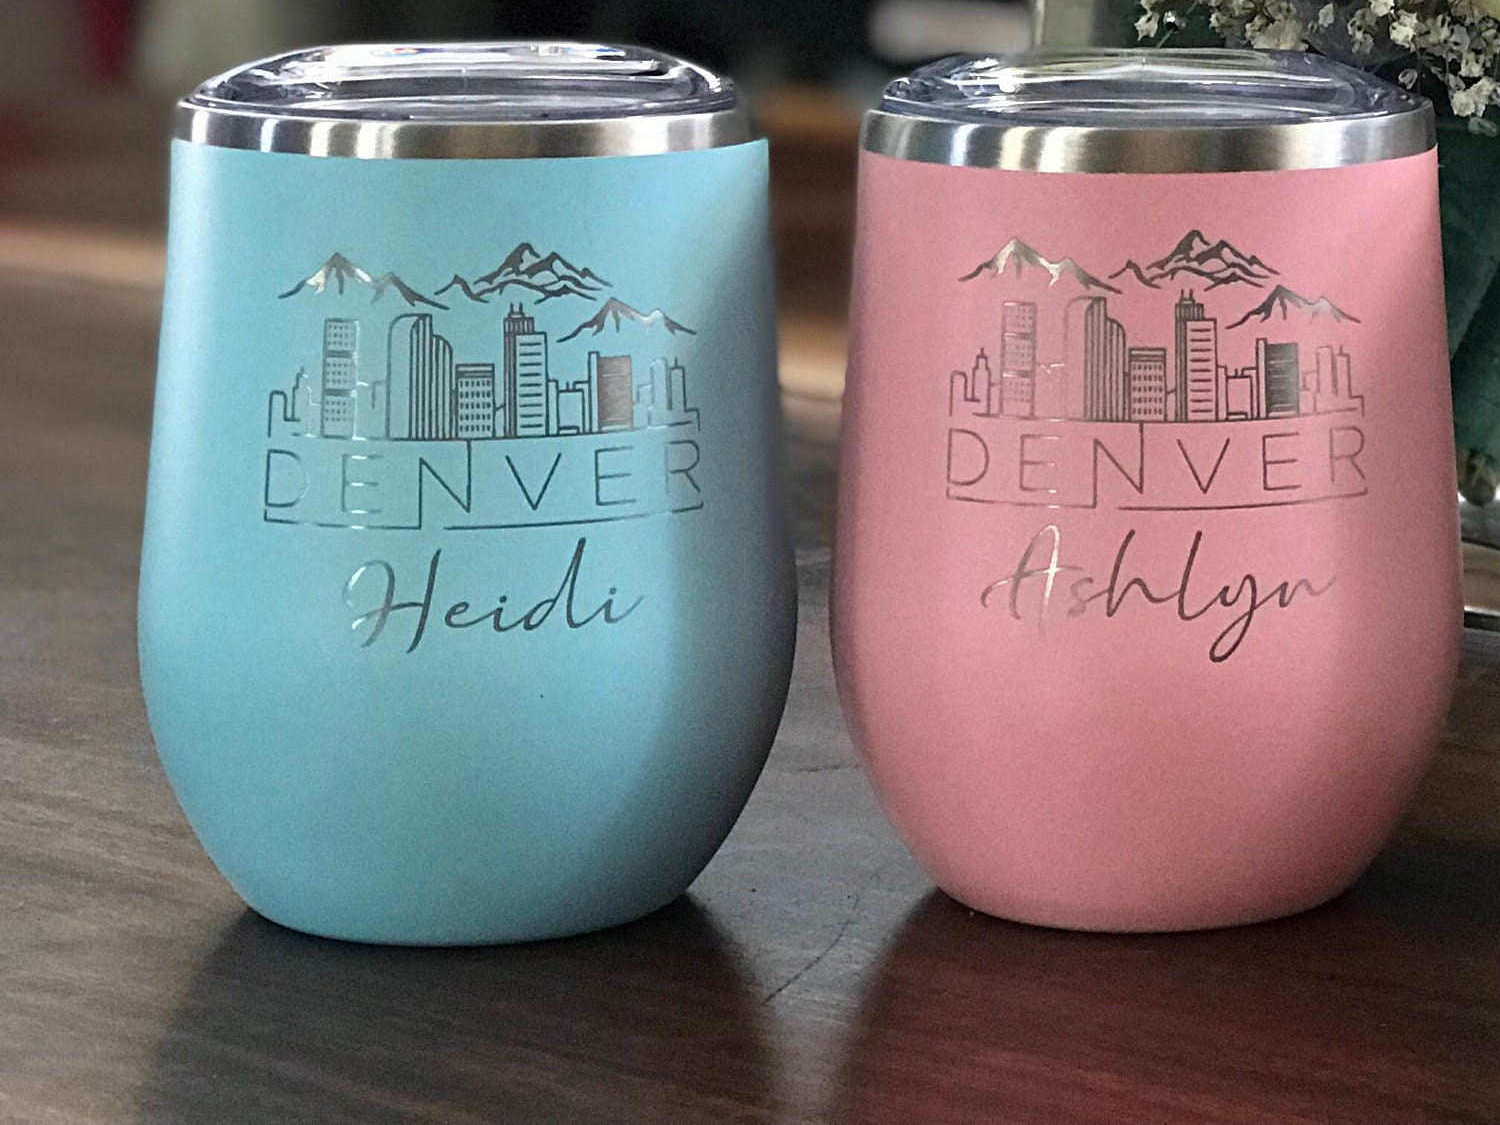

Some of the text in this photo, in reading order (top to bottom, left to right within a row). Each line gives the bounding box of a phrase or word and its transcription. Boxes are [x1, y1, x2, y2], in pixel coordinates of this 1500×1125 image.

[264, 439, 703, 530] DENVER
[946, 423, 1367, 509] DENVER
[341, 537, 644, 654] Heidi
[980, 524, 1336, 663] Ashlyn
